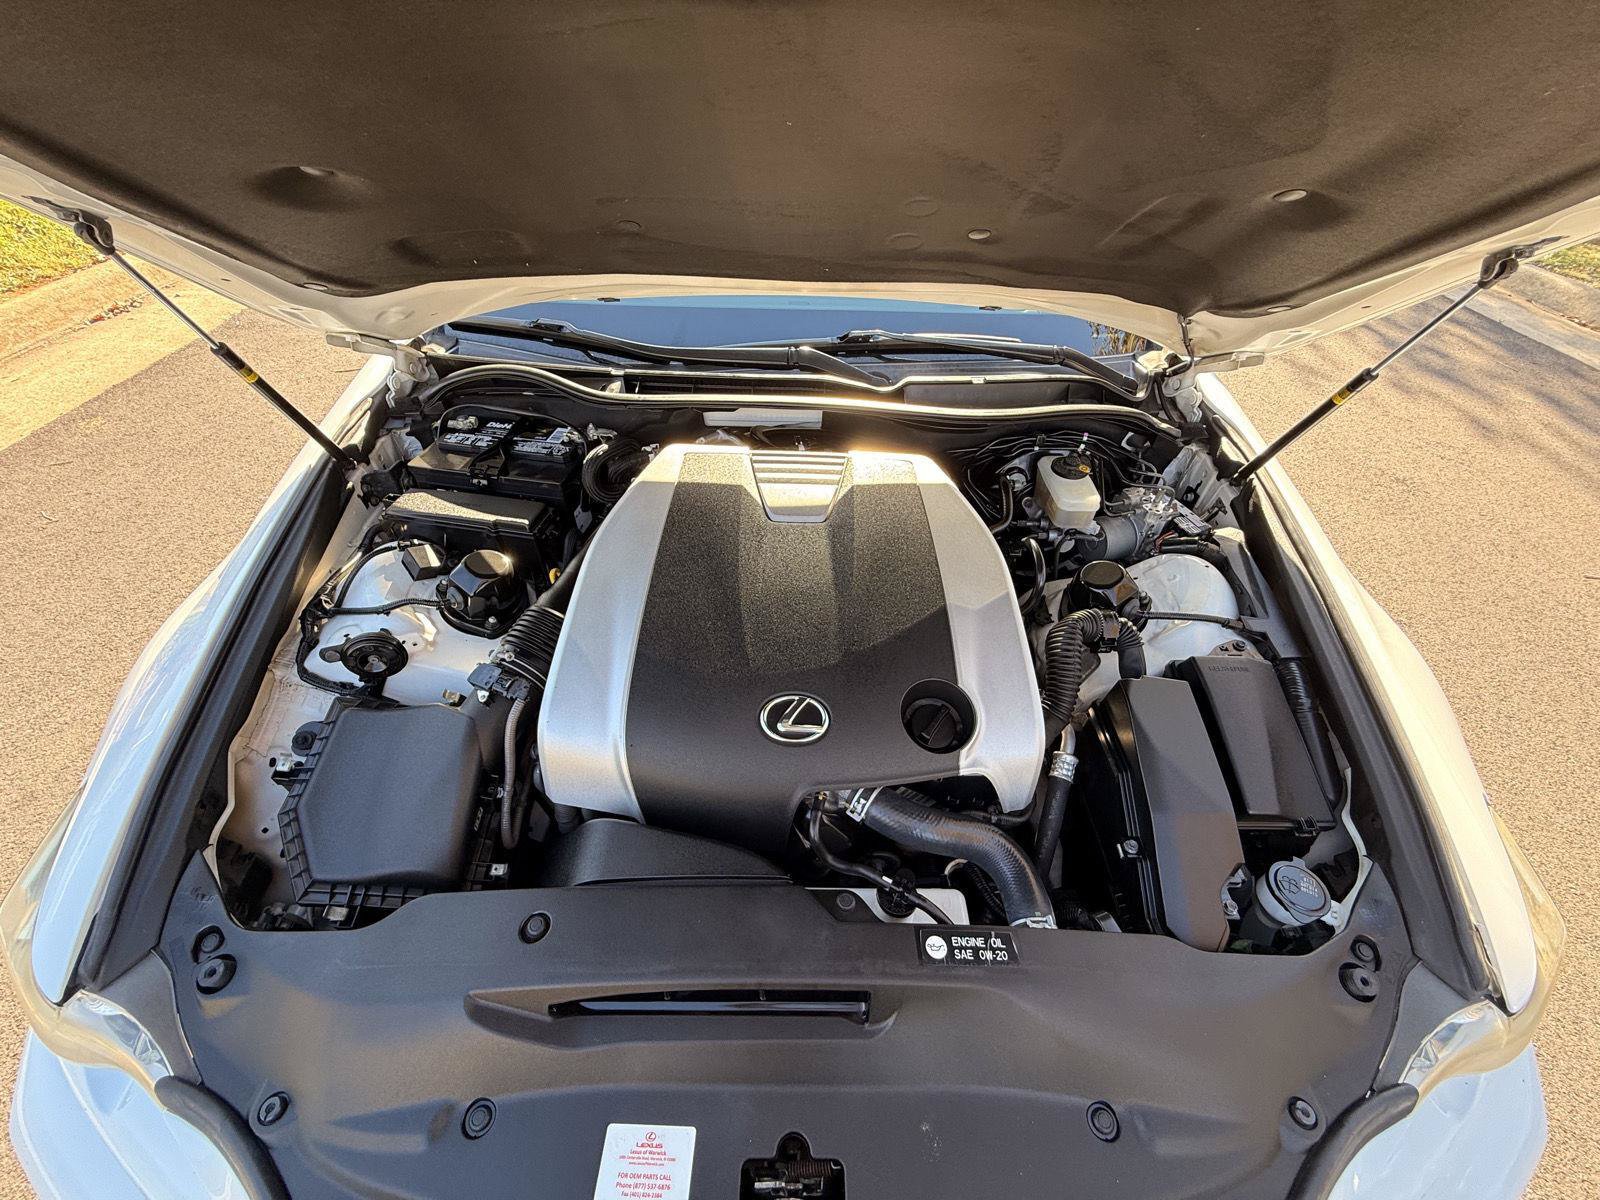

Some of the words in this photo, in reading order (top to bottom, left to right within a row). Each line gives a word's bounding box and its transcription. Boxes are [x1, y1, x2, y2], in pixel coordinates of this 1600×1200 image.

[951, 936, 985, 947] ENGINE
[990, 937, 1006, 948] OIL
[954, 950, 974, 960] SAE
[979, 950, 1008, 961] 0W-20
